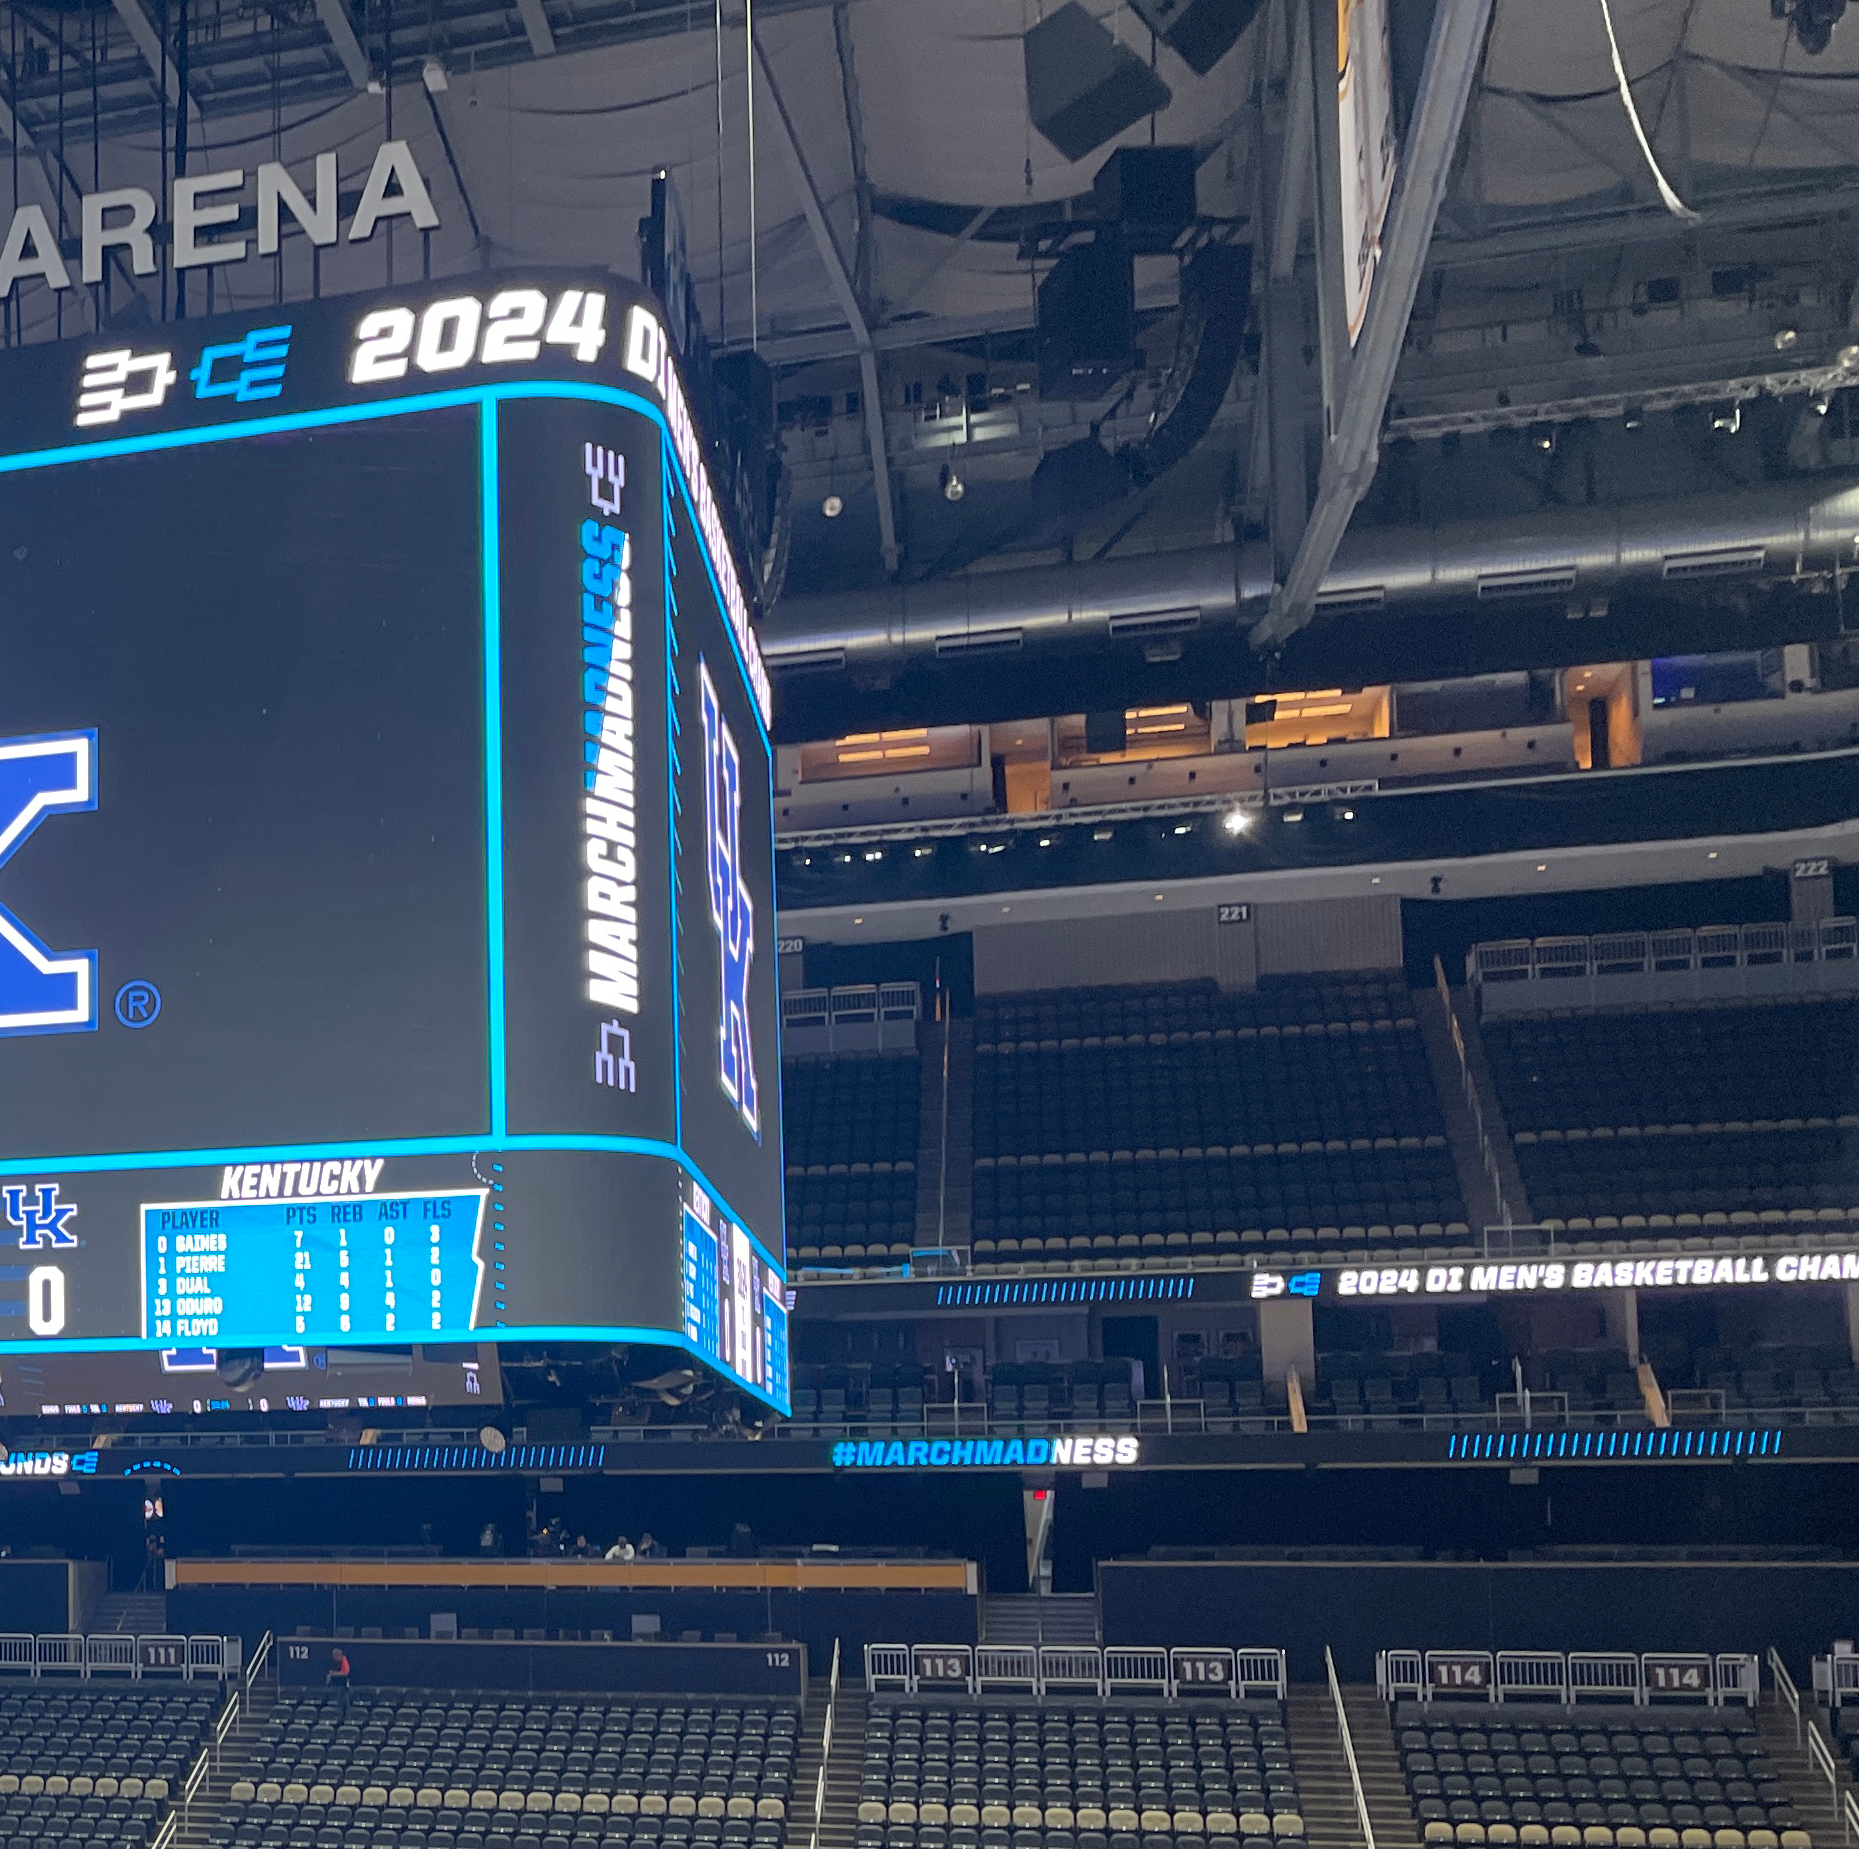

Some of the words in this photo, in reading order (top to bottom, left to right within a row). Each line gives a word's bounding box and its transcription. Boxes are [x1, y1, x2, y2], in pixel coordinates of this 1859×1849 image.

[348, 289, 606, 385] 2024
[580, 518, 640, 1014] MARCHMADNESS
[1795, 860, 1829, 877] 222
[1220, 906, 1248, 922] 221
[220, 1157, 385, 1200] KENTUCKY
[161, 1209, 220, 1230] PLAYER
[285, 1205, 317, 1226] PTS
[331, 1203, 363, 1224] REB
[378, 1201, 410, 1221] AST
[423, 1199, 452, 1220] FLS
[157, 1235, 168, 1253] 0
[294, 1230, 304, 1248] 7
[339, 1228, 347, 1247] 1
[384, 1226, 395, 1245] 0
[158, 1256, 167, 1274] 1
[176, 1254, 226, 1273] PIERRE
[295, 1251, 312, 1270] 21
[385, 1248, 393, 1266] 1
[430, 1246, 440, 1265] 2
[176, 1276, 211, 1295] DUAL
[294, 1272, 305, 1291] 4
[385, 1269, 394, 1288] 1
[431, 1268, 442, 1287] 0
[1337, 1267, 1420, 1296] 2024
[1426, 1266, 1465, 1293] DI
[1470, 1263, 1566, 1291] MEN'S
[1571, 1257, 1770, 1289] BASKETBALL
[28, 1265, 67, 1337] 0
[295, 1294, 312, 1312] 12
[431, 1290, 441, 1308] 2
[155, 1319, 172, 1338] 14
[176, 1318, 219, 1337] FLOYD
[385, 1313, 395, 1332] 2
[431, 1311, 442, 1330] 2
[832, 1437, 1140, 1467] #MARCHMADNESS
[148, 1647, 176, 1665] 111
[288, 1645, 309, 1660] 112
[766, 1651, 790, 1667] 112
[922, 1657, 962, 1679] 113
[1183, 1661, 1224, 1682] 113
[1437, 1663, 1482, 1686] 114
[1655, 1667, 1701, 1688] 114
